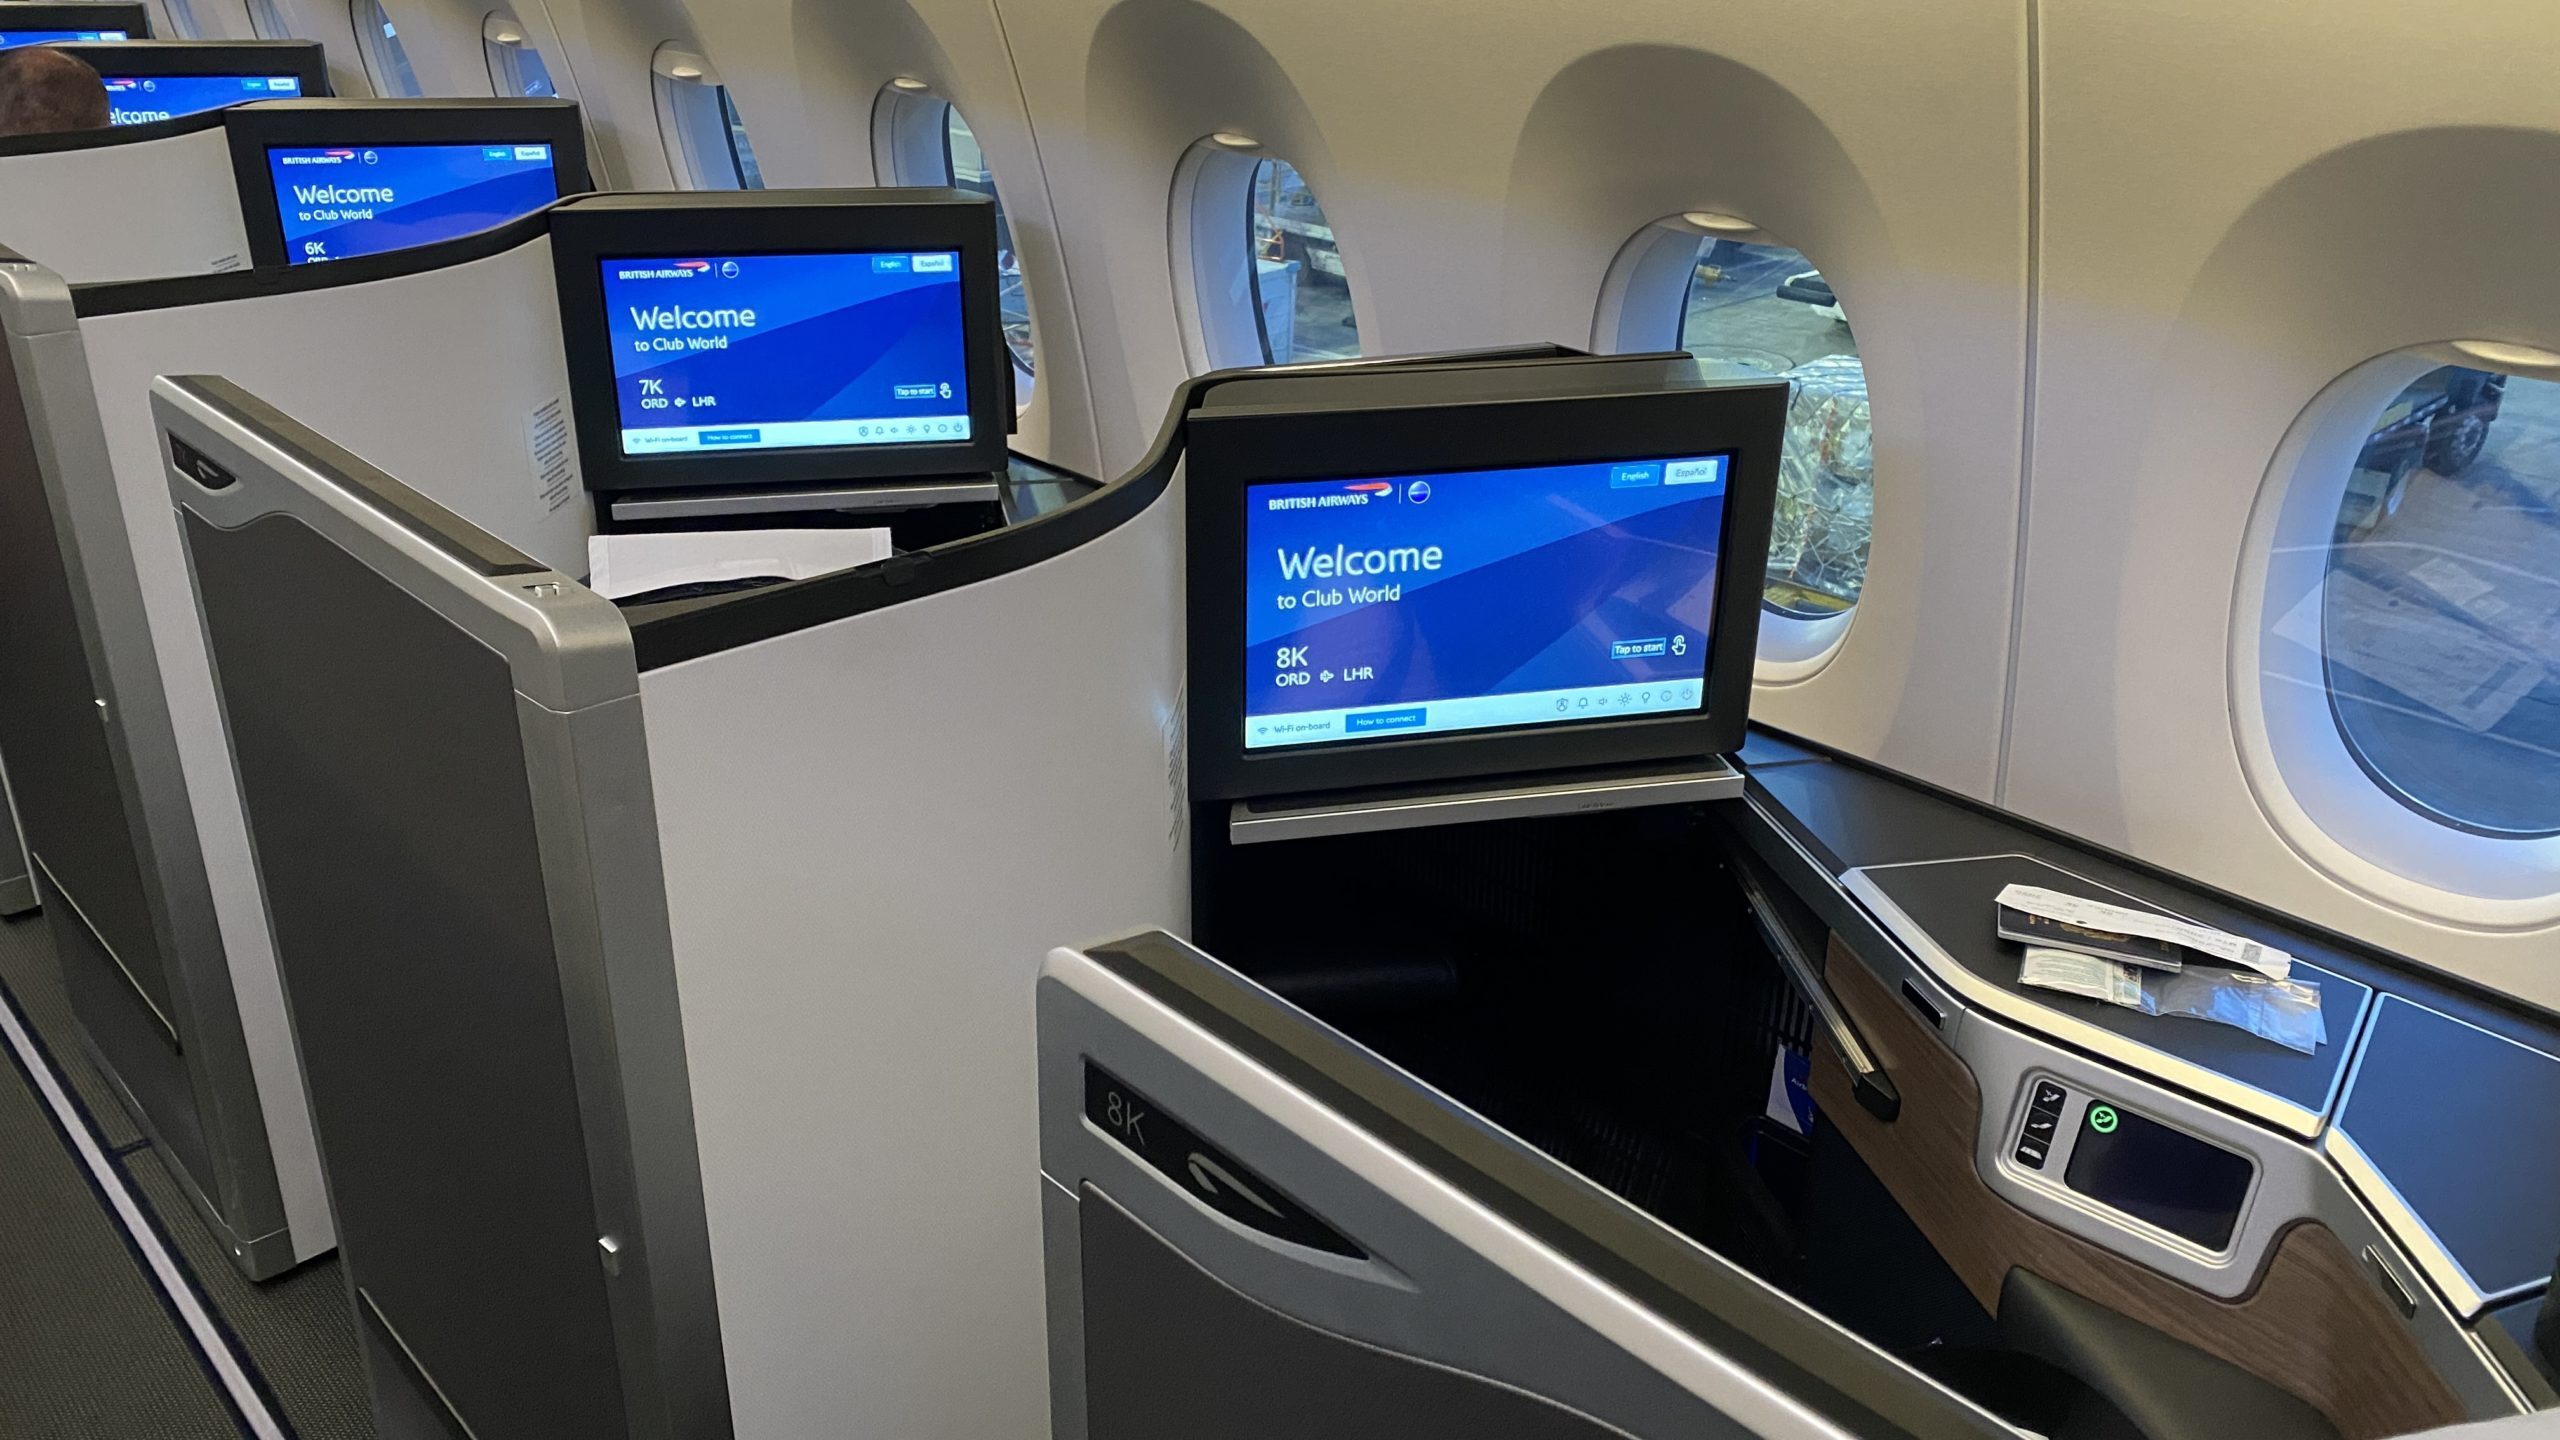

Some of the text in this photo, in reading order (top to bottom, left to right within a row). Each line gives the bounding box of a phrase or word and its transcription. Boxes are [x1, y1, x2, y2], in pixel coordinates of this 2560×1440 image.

[109, 107, 170, 125] elcome
[282, 156, 342, 165] BRITISH AIRWAYS
[293, 184, 394, 204] Welcome
[299, 208, 374, 221] to Club World
[304, 242, 326, 255] 6K
[619, 269, 694, 280] BRITISH AIRWAYS
[630, 304, 757, 331] Welcome
[634, 335, 728, 352] to Club World
[638, 379, 664, 396] 7K
[641, 396, 717, 409] ORD LHR
[1621, 471, 1650, 483] English
[1675, 467, 1708, 479] Español
[1268, 494, 1369, 511] BRITISH AIRWAYS
[1277, 543, 1443, 581] Welcome
[1277, 583, 1401, 610] to Club World
[1276, 646, 1309, 669] 8K
[1614, 643, 1664, 656] Tap to start
[1275, 666, 1374, 687] ORD LHR
[1274, 722, 1331, 734] Wi-Fi on-board
[1356, 714, 1416, 726] How to connect
[1107, 1090, 1145, 1147] 8K
